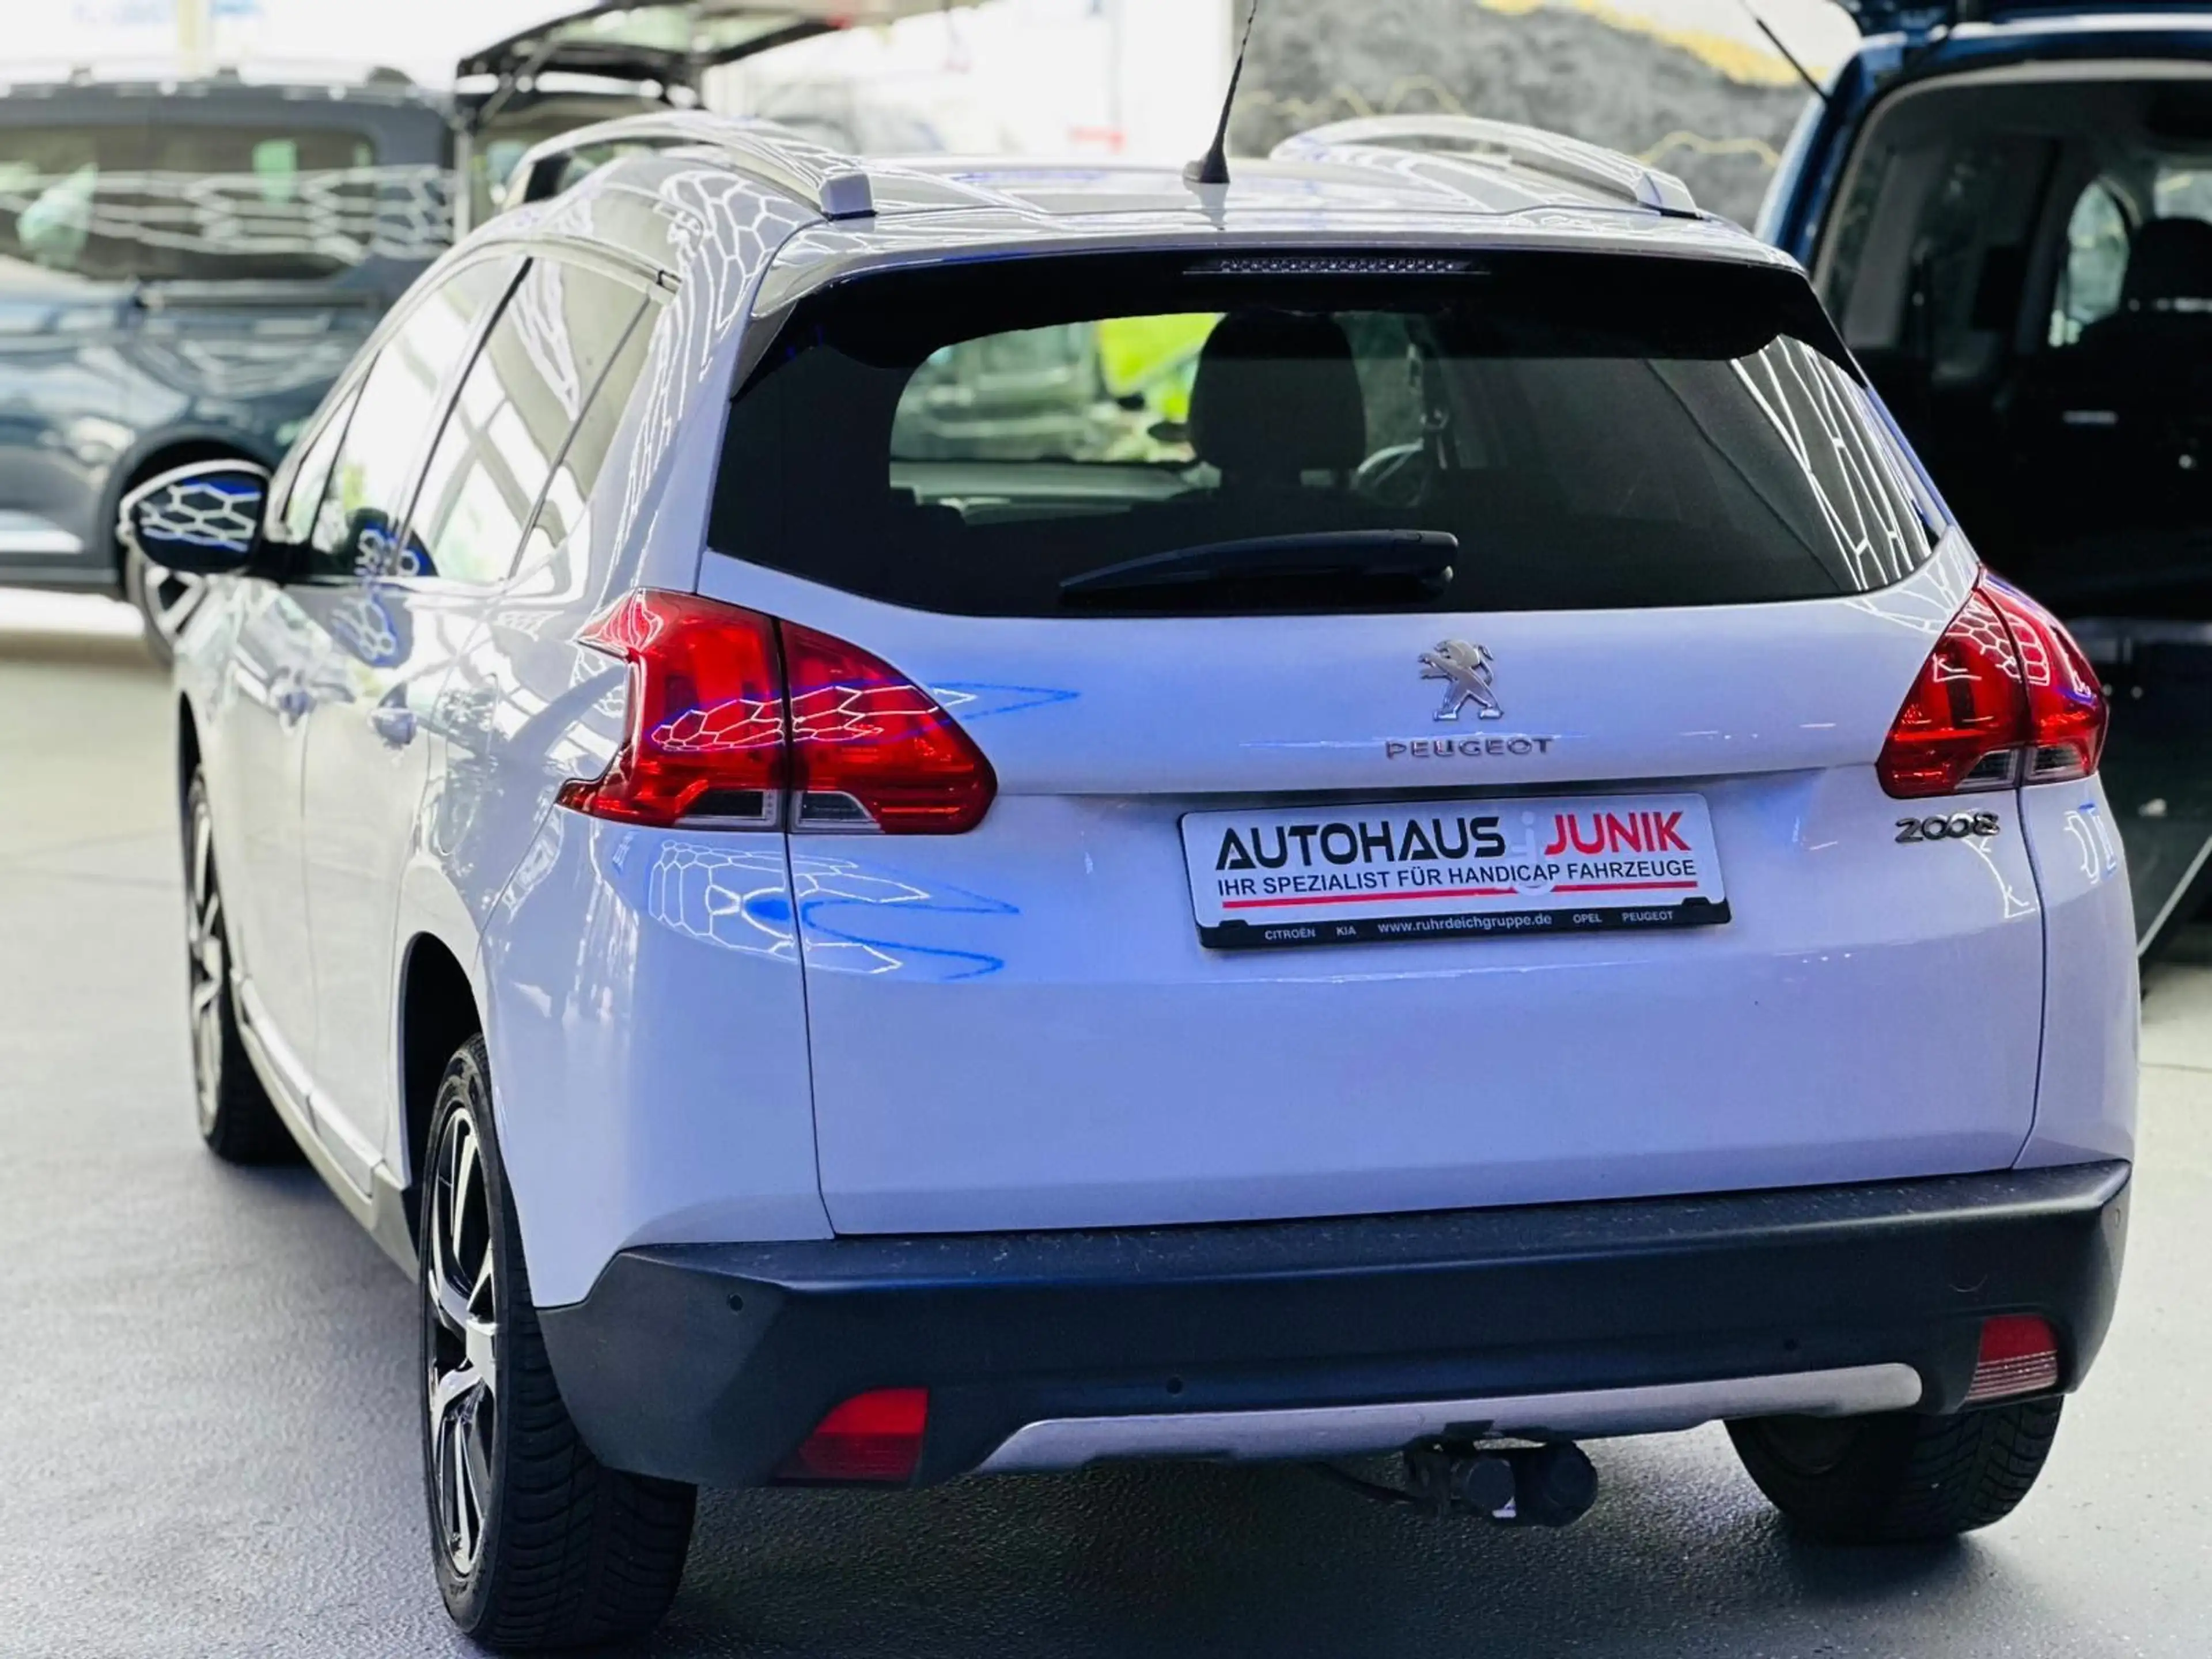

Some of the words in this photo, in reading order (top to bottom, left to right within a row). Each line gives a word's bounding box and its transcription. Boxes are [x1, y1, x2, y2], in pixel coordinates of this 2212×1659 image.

[1385, 737, 1553, 759] PEUGEOT
[1215, 816, 1505, 870] AUTOHAUS
[1544, 811, 1691, 855] JUNIK
[1895, 812, 2001, 844] 2008
[1218, 878, 1256, 896] IHR
[1264, 871, 1389, 894] SPEZIALIST
[1398, 866, 1443, 887] FÜR
[1449, 864, 1560, 884] HANDICAP
[1568, 860, 1696, 880] FAHRZEUGE
[1336, 925, 1356, 936] KIA
[1378, 913, 1552, 933] www.ruhrdeichgruppe.de
[1573, 914, 1602, 923] OPEL
[1622, 911, 1674, 922] PEUGEOT
